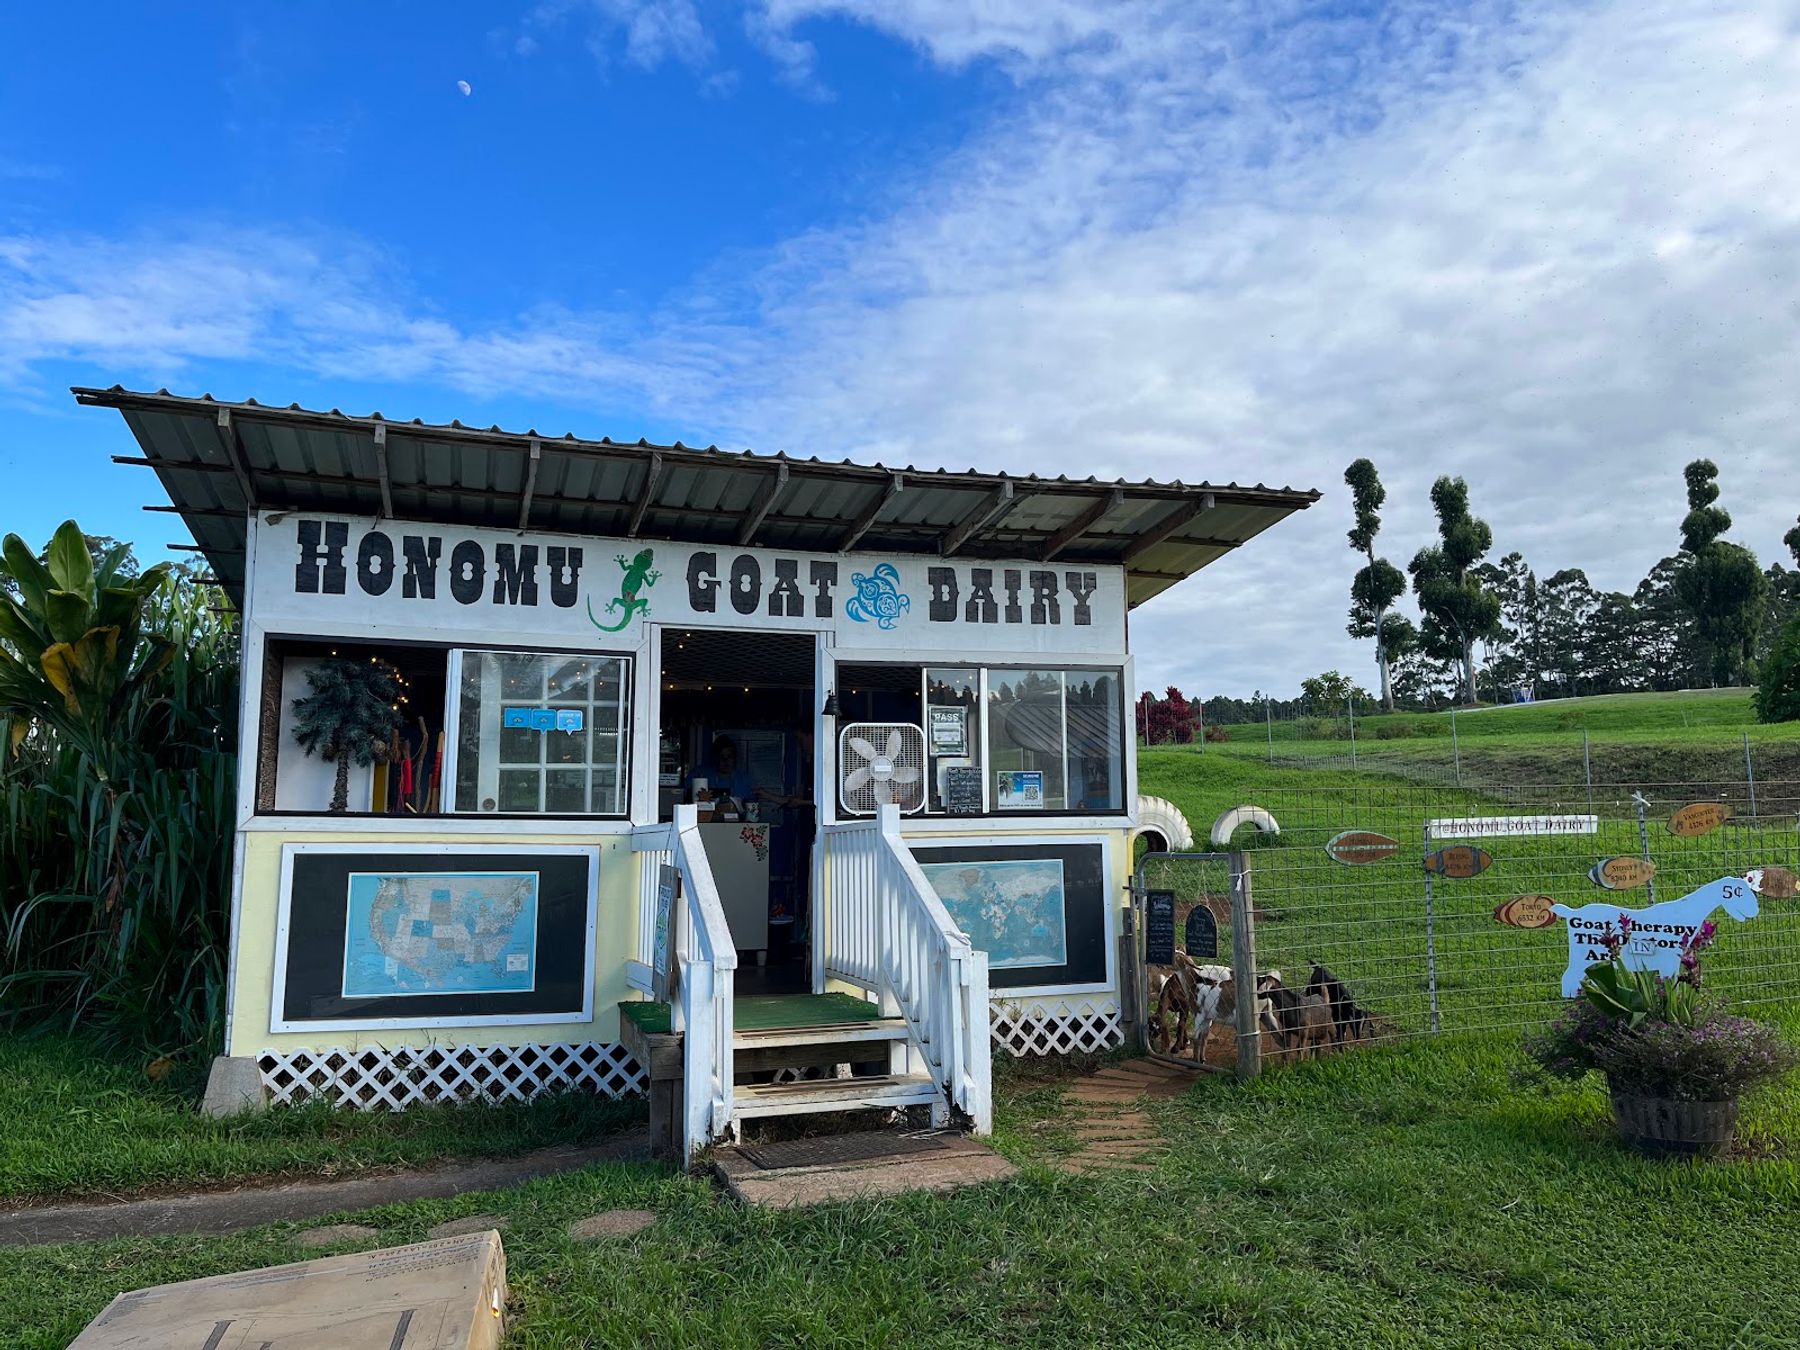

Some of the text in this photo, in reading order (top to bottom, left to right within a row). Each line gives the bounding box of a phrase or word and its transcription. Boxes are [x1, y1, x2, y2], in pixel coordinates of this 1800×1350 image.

[295, 519, 1098, 625] HONOMU GOAT DAIRY
[934, 712, 959, 722] PASS
[1611, 864, 1633, 872] SYDNEY
[1722, 885, 1743, 899] 5¢
[1569, 917, 1697, 938] Goat herapy
[1574, 933, 1604, 947] Th
[1633, 942, 1651, 952] IN
